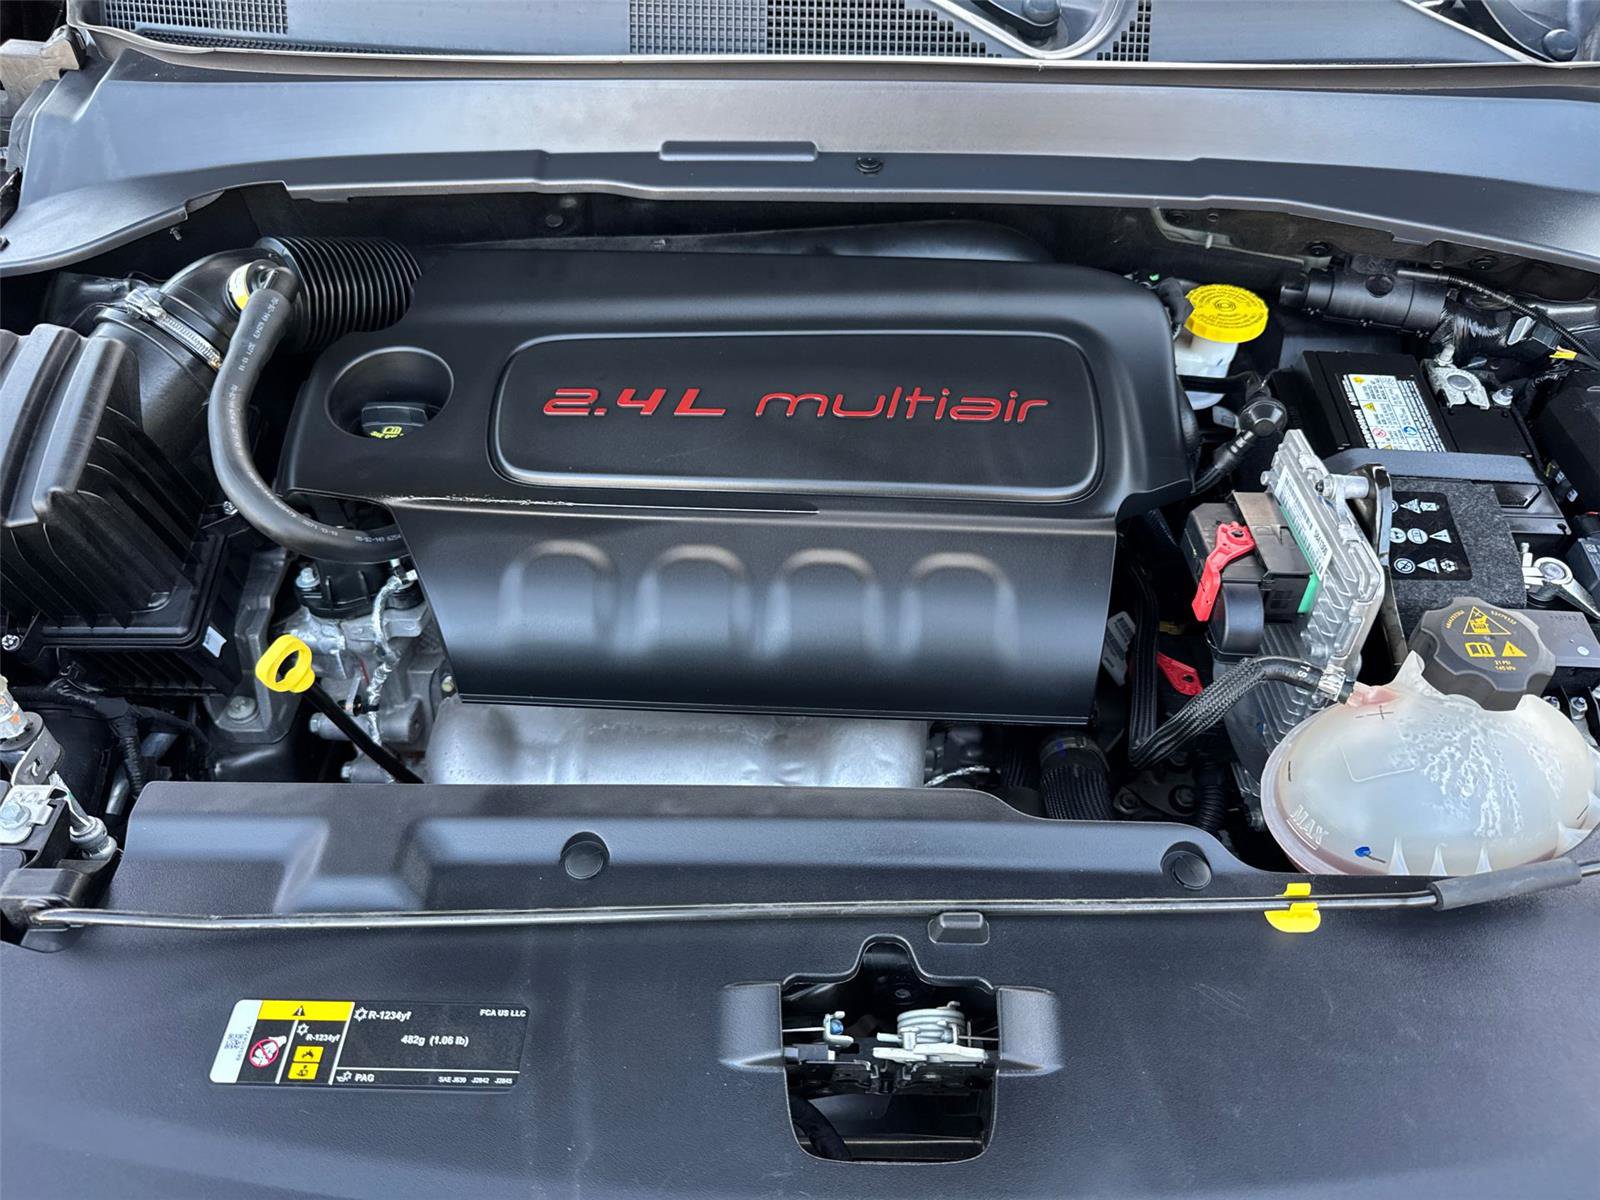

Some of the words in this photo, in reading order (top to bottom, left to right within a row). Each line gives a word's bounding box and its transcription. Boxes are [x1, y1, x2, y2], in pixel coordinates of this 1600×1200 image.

[542, 387, 727, 417] 2.4L
[754, 386, 1049, 422] multiair
[1289, 803, 1329, 845] MAX
[367, 1010, 412, 1022] R-1234yf
[479, 1009, 498, 1018] FCA
[498, 1009, 510, 1018] US
[510, 1010, 527, 1018] LLC
[305, 1033, 341, 1043] R-1234yf
[400, 1034, 426, 1047] 482g
[429, 1035, 454, 1047] (1.06
[455, 1035, 470, 1048] lb)
[354, 1073, 375, 1082] PAG
